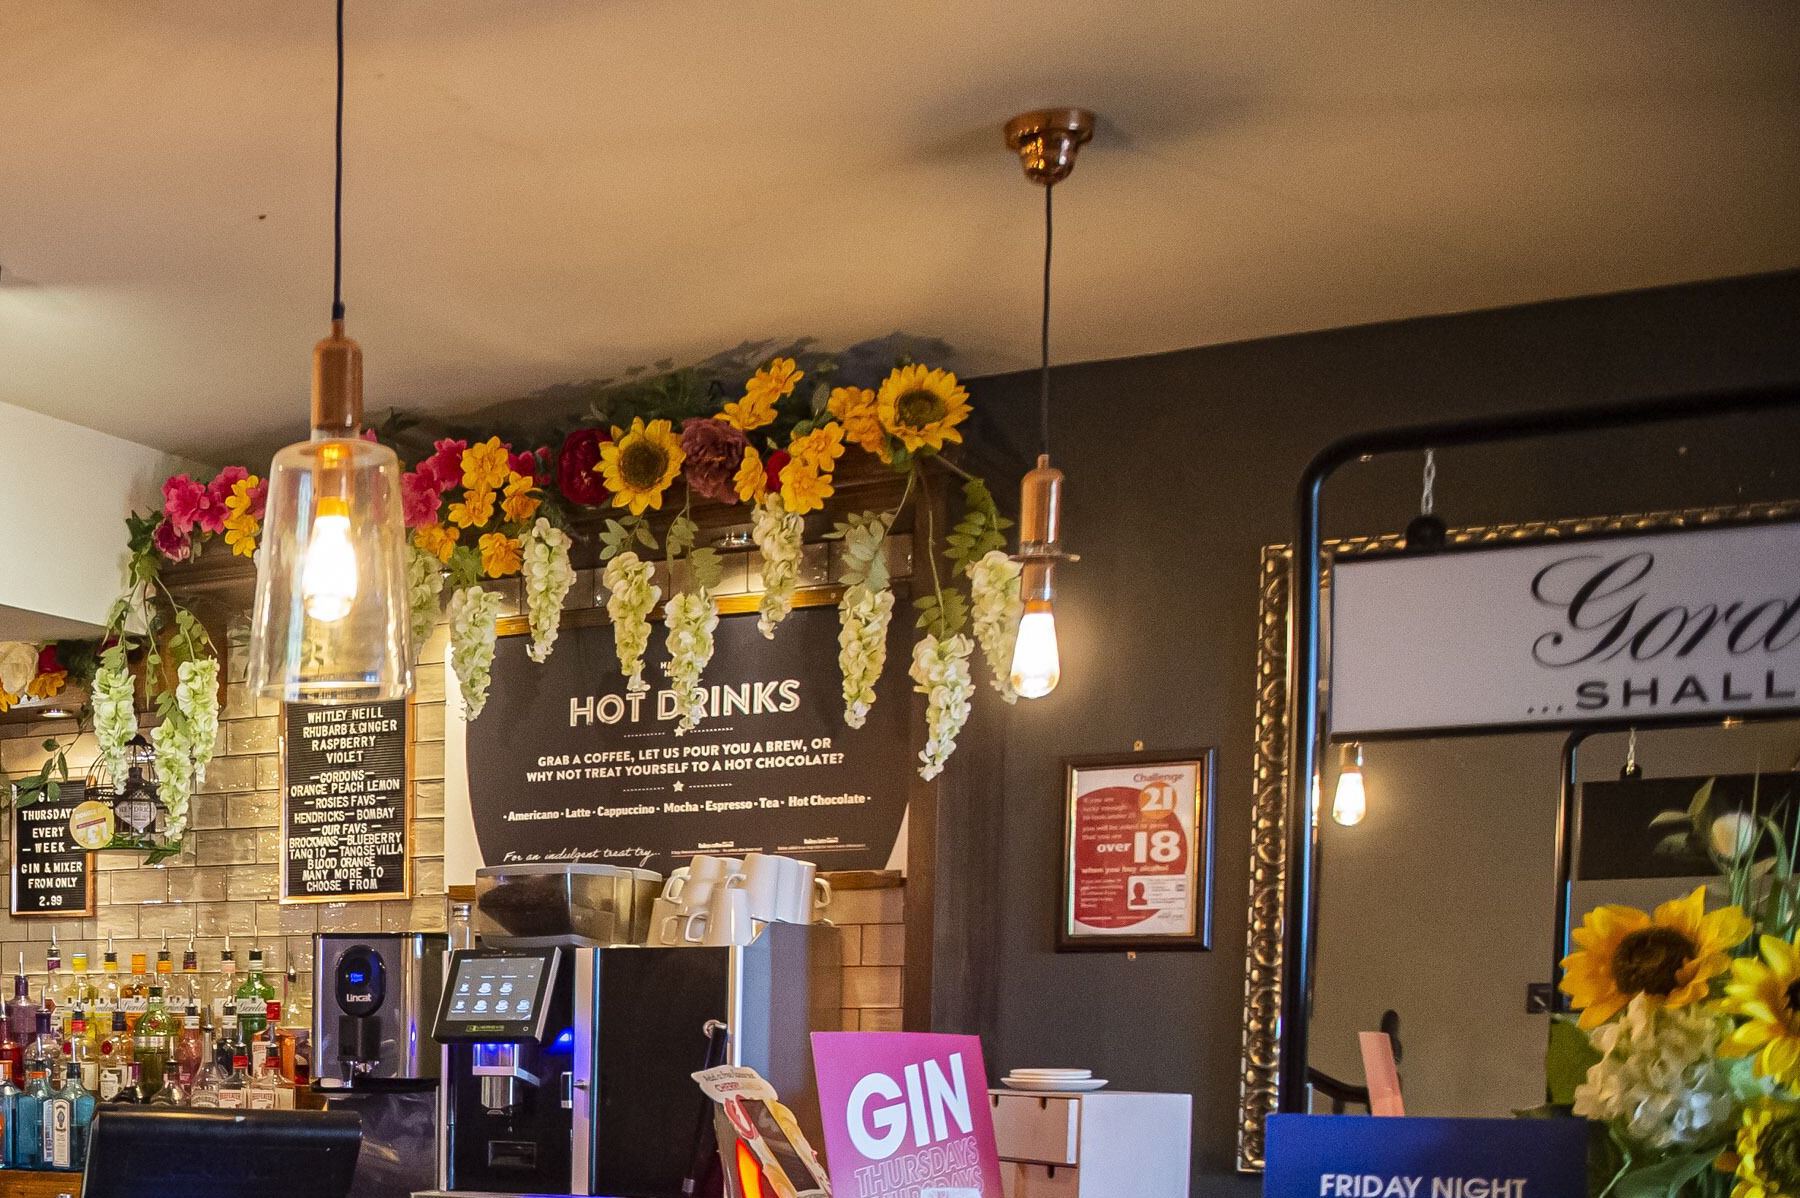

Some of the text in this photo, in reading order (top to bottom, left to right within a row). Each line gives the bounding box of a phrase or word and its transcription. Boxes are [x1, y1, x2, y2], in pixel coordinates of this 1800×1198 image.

[569, 679, 800, 727] HOT DRINKS
[307, 707, 384, 724] WHITLEY NEILL
[303, 719, 397, 738] RHUBARB & GINGER
[312, 736, 376, 751] RASPBERRY
[326, 750, 364, 764] VIOLET
[538, 737, 831, 767] GRAB A COFFEE, LET US POUR YOU A BREW, OR
[527, 753, 844, 782] WHY NOT TREAT YOURSELF TO A HOT CHOCOLATE?
[291, 779, 400, 797] ORANGE PEACH LEMON
[566, 808, 591, 818] Latte
[597, 804, 655, 818] Cappuccino
[663, 801, 699, 813] Mocha
[705, 800, 752, 813] Espresso
[759, 797, 780, 809] Tea
[788, 796, 810, 807] Hot
[810, 793, 866, 806] Chocolate
[1142, 787, 1174, 811] 21
[22, 808, 73, 821] THURSDAY
[357, 807, 395, 820] BOMBAY
[32, 827, 65, 838] EVERY
[342, 824, 368, 834] FAVS
[35, 842, 65, 853] WEEK
[1097, 830, 1180, 863] over 18
[308, 856, 375, 869] BLOOD ORANGE
[503, 851, 523, 862] For
[526, 854, 541, 862] an
[544, 848, 599, 863] indulgent
[603, 848, 631, 858] treat
[21, 861, 83, 874] GIN & MIXER
[303, 866, 384, 881] MANY MORE TO
[28, 877, 78, 888] FROM ONLY
[306, 879, 378, 892] CHOOSE FROM
[39, 896, 62, 906] 2.99
[846, 1052, 973, 1161] GIN
[854, 1136, 979, 1198] THURSDAYS
